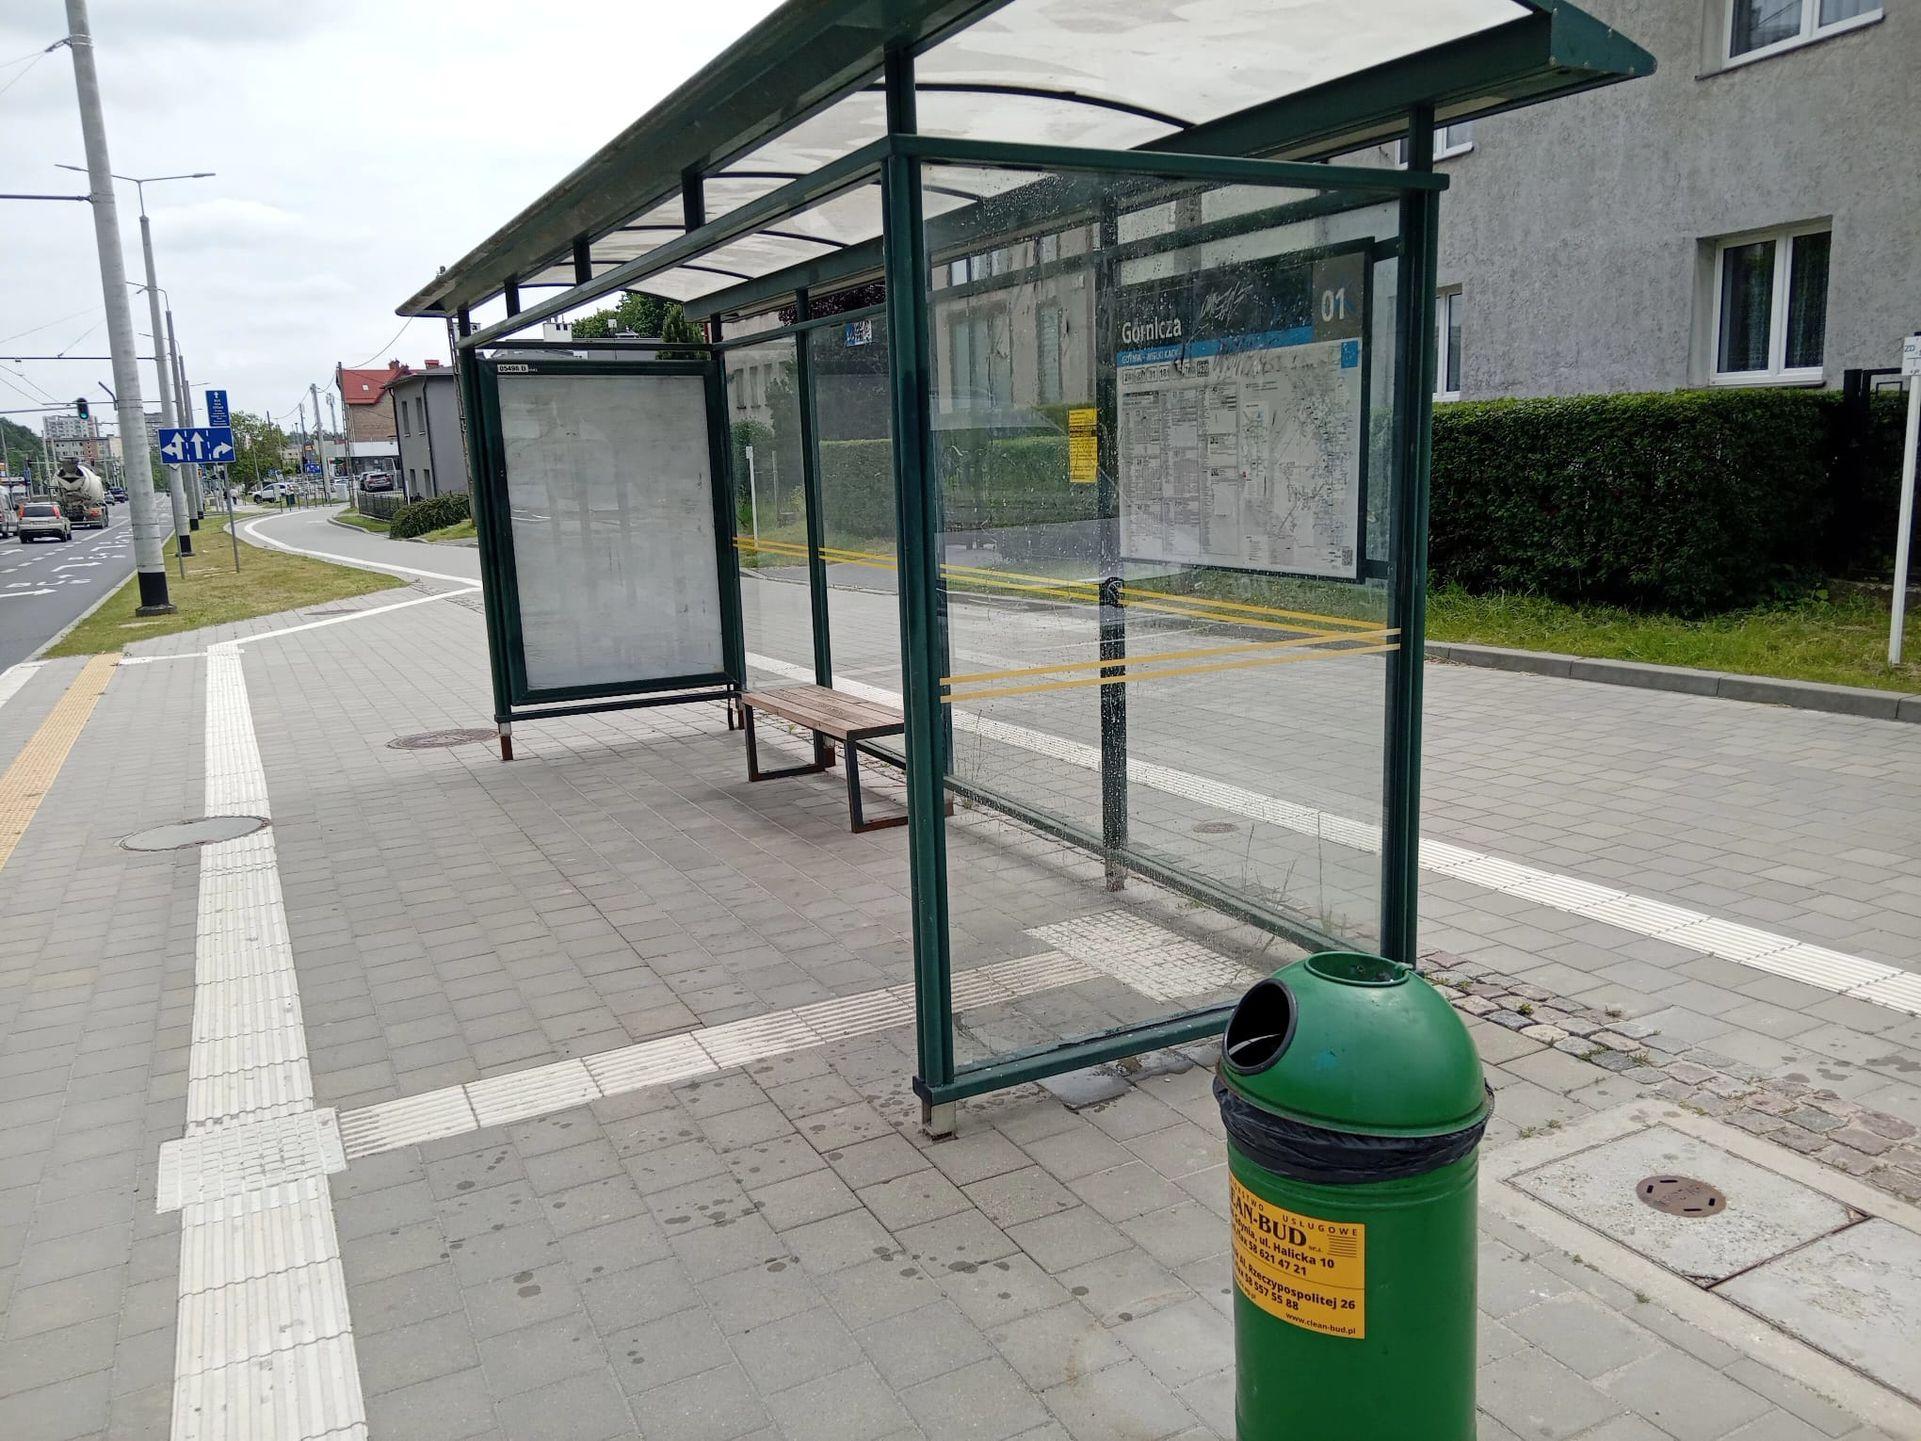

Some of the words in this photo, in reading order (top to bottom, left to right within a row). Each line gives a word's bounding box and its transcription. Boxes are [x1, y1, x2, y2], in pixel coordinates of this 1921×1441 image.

[1321, 288, 1345, 322] 01
[1259, 1236, 1271, 1249] ul.
[1273, 1241, 1316, 1265] Halicka
[1320, 1258, 1335, 1268] 10
[1259, 1248, 1275, 1264] 621
[1278, 1258, 1291, 1271] 47
[1293, 1264, 1307, 1276] 21
[1248, 1263, 1338, 1310] Rzeczypospolitej
[1341, 1299, 1356, 1310] 26
[1254, 1281, 1269, 1297] 557
[1271, 1291, 1283, 1305] 55
[1286, 1298, 1299, 1311] 88
[1284, 1312, 1356, 1335] www.clean-bud.pl
